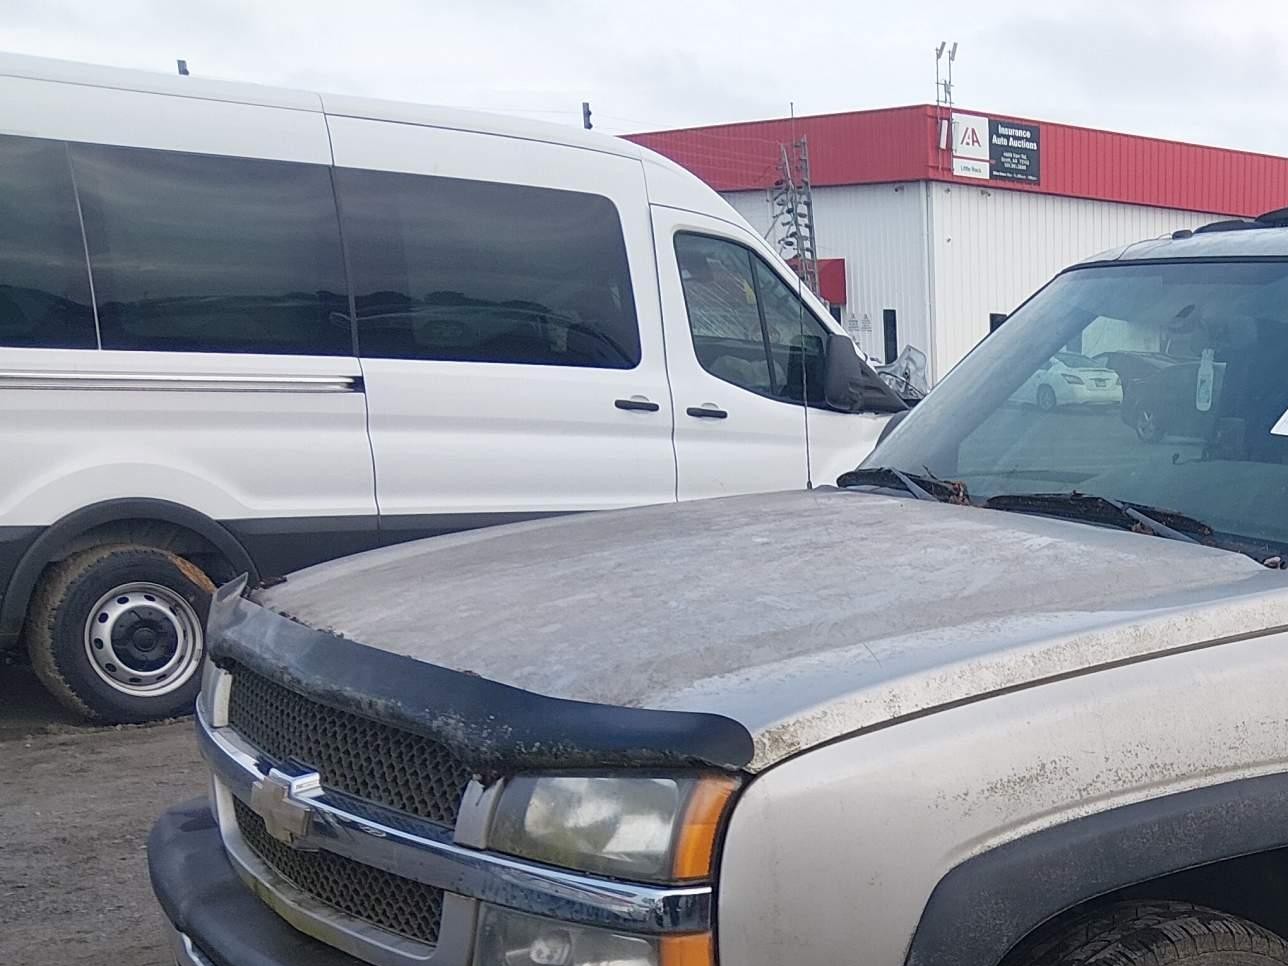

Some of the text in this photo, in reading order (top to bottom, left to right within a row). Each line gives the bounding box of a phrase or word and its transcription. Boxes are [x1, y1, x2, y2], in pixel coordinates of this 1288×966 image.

[998, 124, 1030, 138] Insurance
[992, 135, 1037, 150] Auto Auctions
